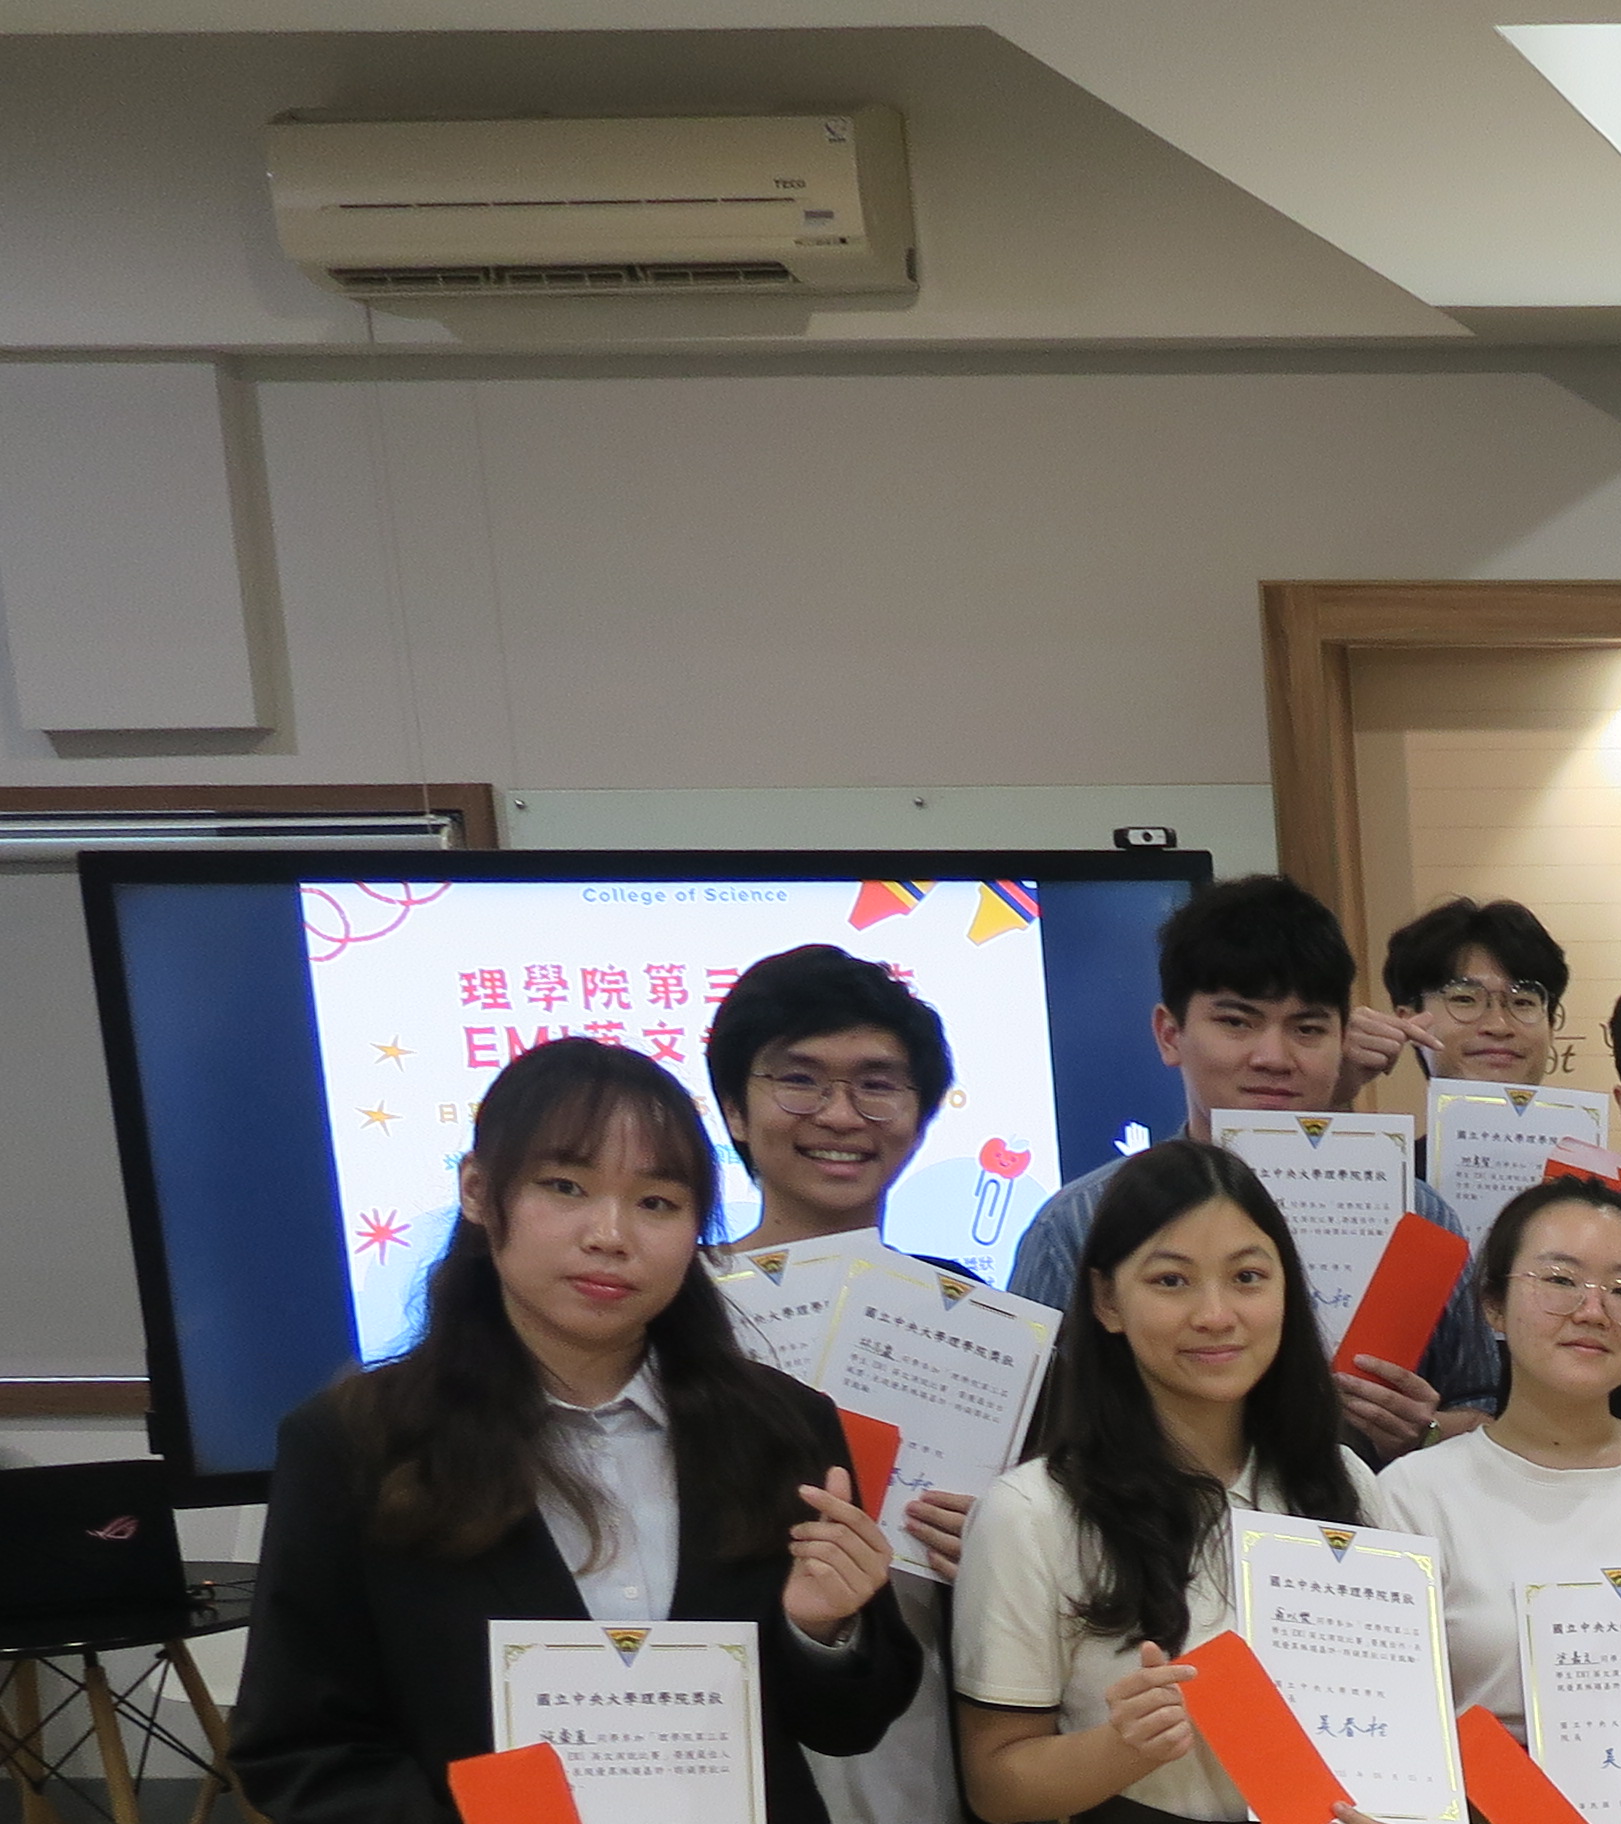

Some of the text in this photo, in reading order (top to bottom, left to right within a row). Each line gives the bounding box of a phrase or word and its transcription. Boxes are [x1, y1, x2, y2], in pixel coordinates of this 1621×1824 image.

[581, 886, 789, 905] College of Science
